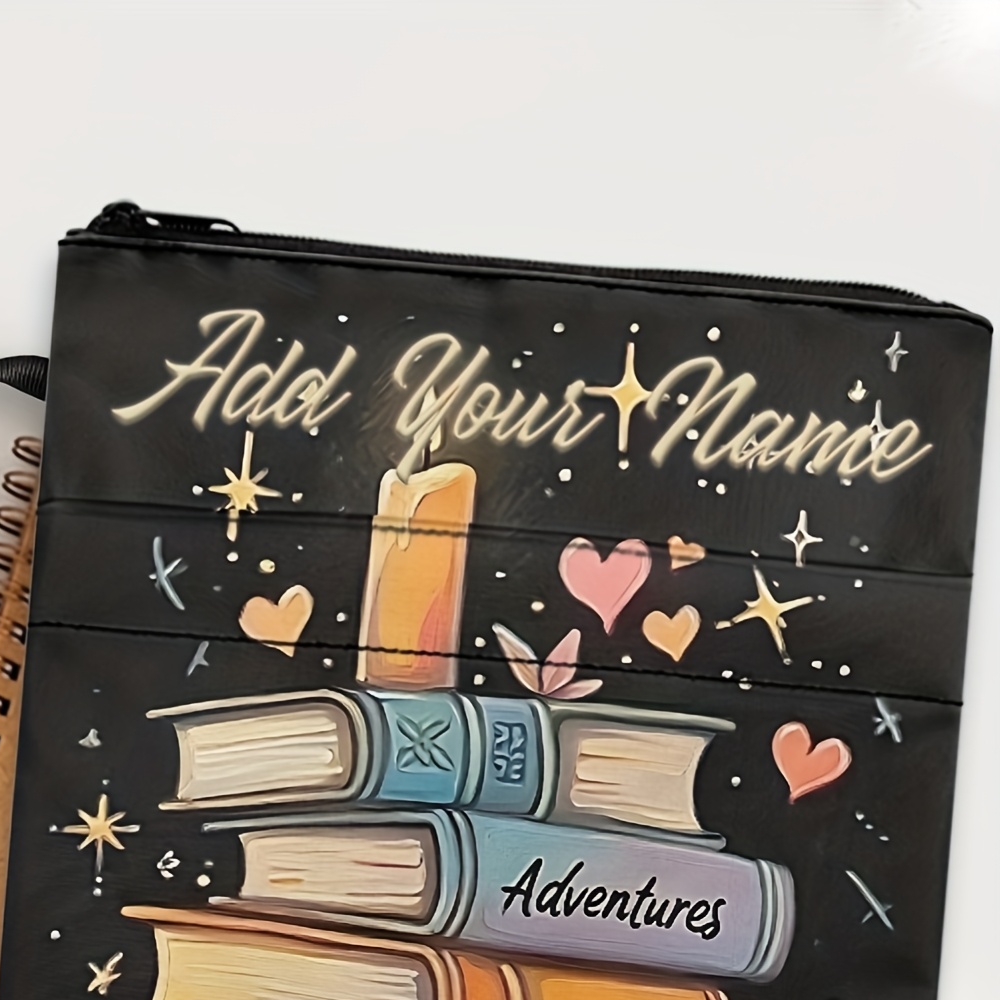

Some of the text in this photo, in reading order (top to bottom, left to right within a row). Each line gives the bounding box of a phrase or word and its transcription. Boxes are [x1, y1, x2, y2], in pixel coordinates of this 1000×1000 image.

[111, 308, 934, 482] Add Your Name
[501, 858, 727, 940] Adventures
